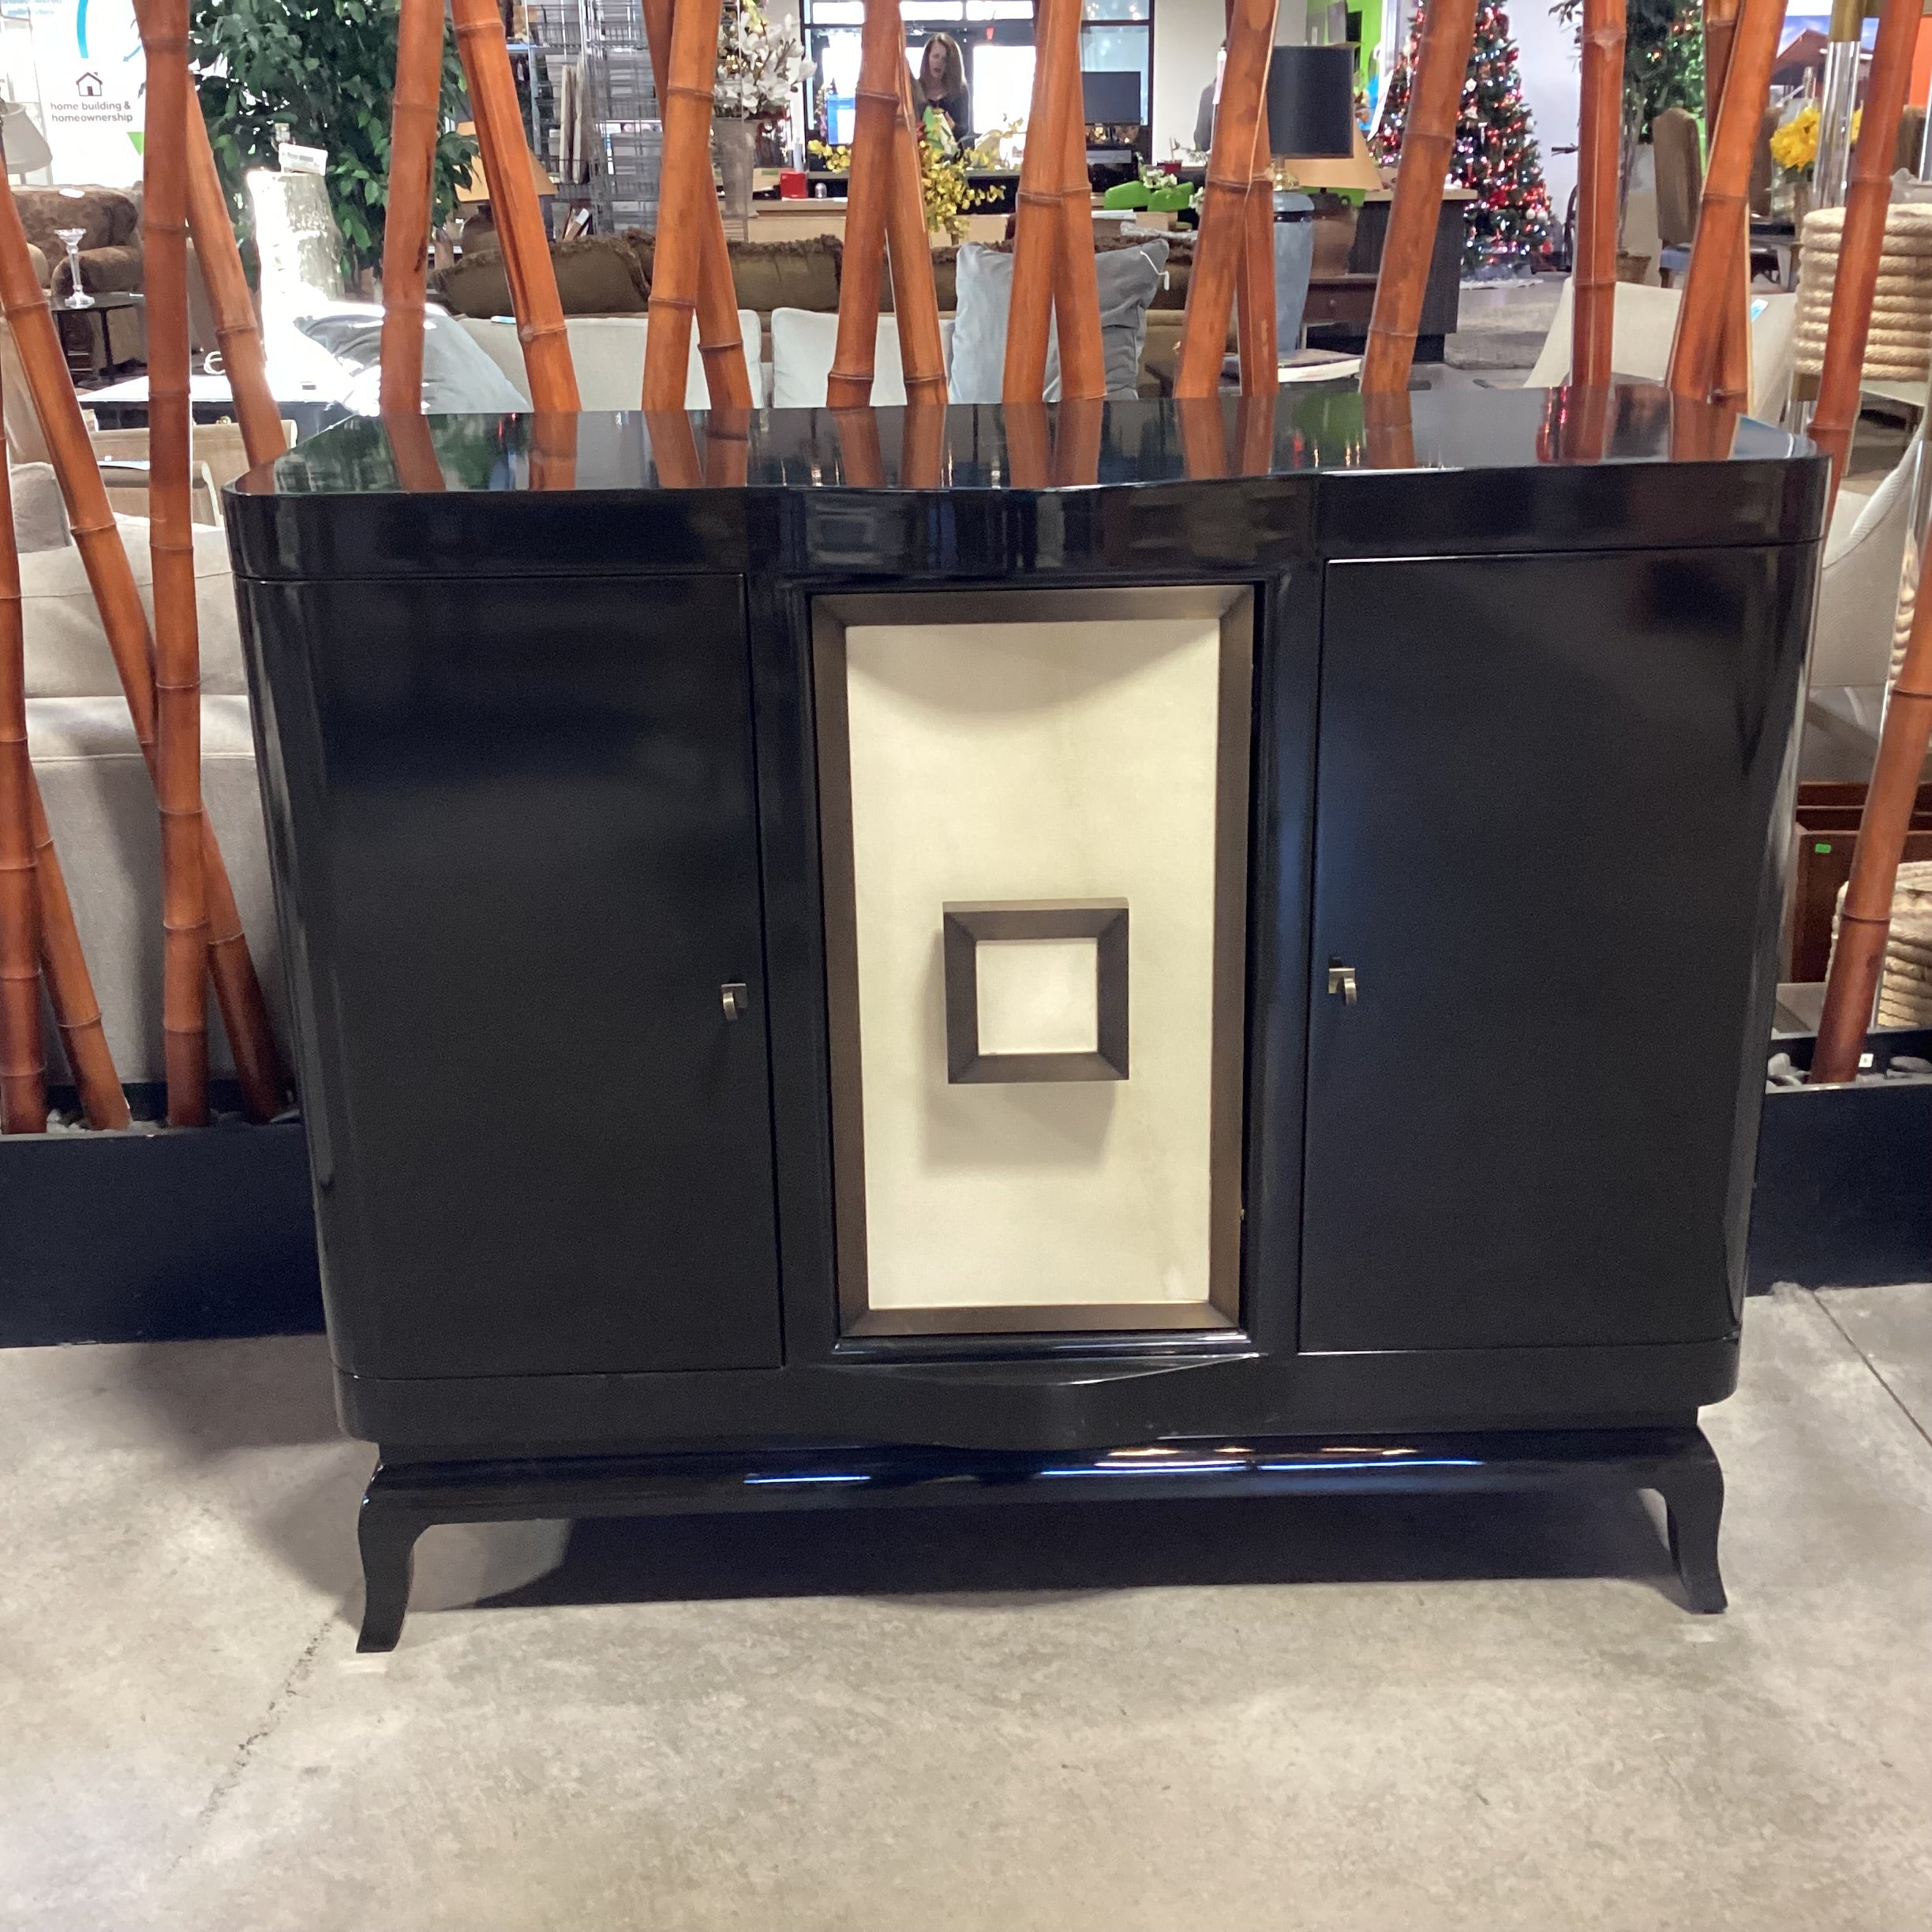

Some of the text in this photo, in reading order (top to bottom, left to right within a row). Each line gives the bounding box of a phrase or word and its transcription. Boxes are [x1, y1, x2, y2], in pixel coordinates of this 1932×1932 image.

[81, 102, 122, 111] building
[124, 101, 131, 110] &
[51, 113, 133, 122] homeownership
